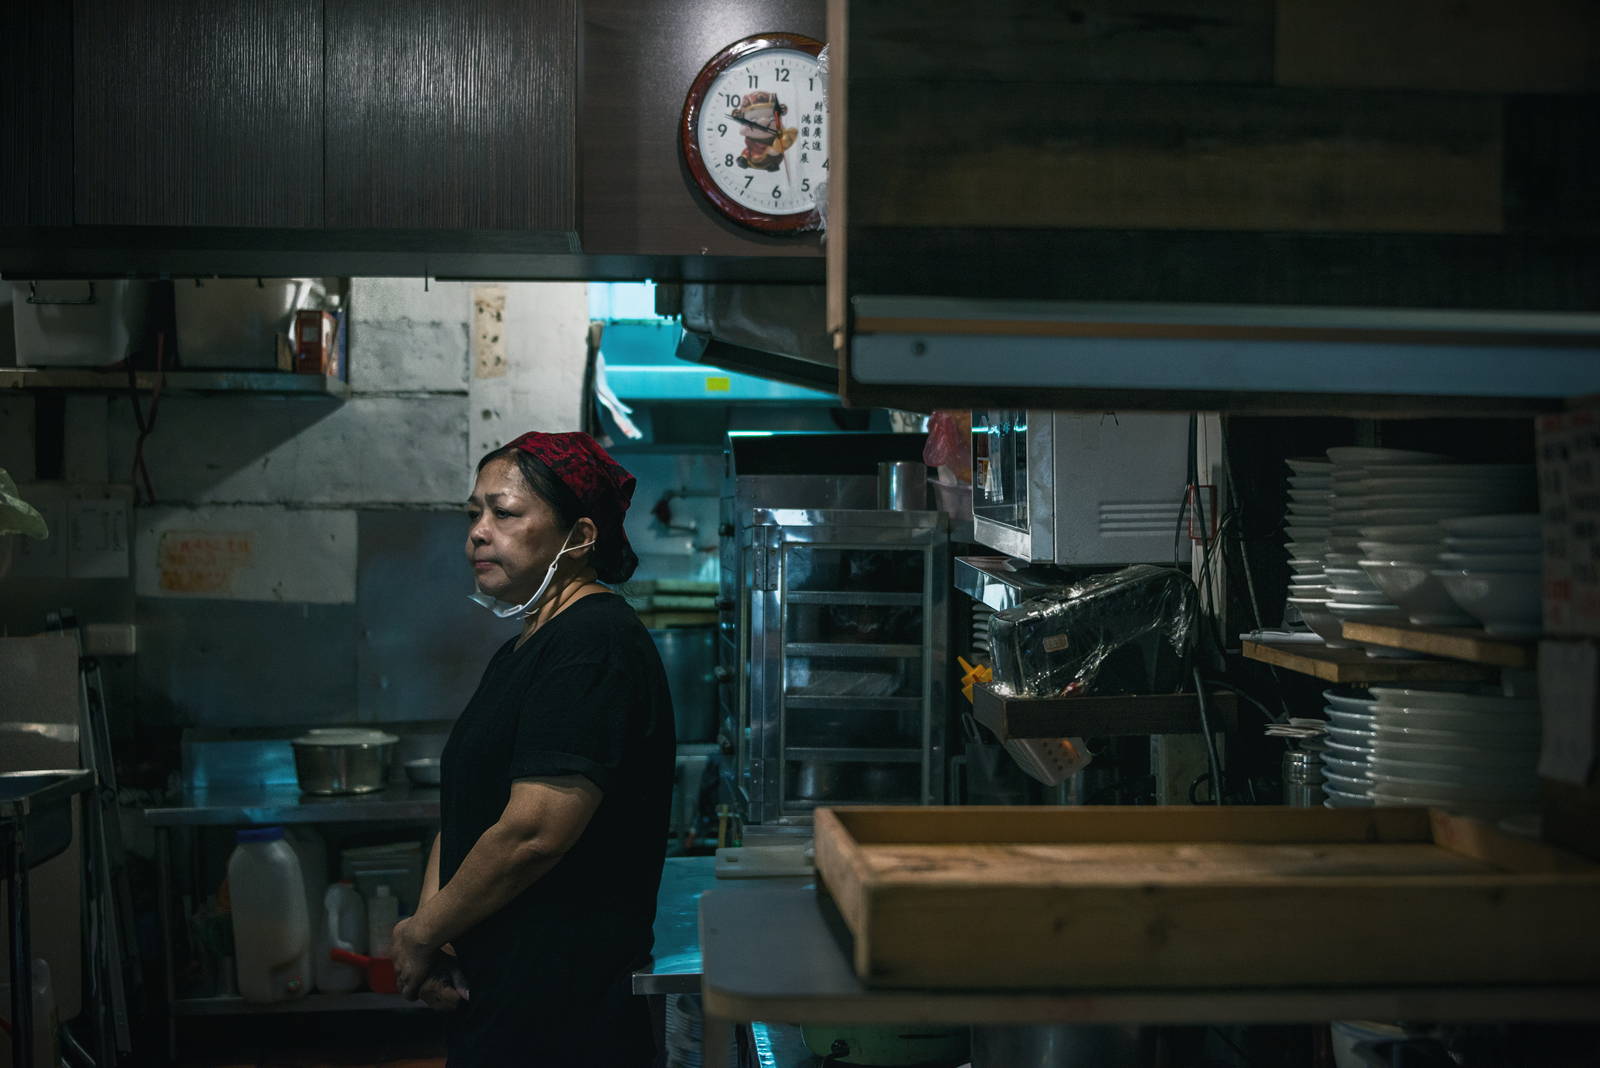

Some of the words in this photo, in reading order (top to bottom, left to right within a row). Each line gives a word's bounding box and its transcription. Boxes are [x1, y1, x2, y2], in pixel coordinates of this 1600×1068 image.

[775, 68, 790, 82] 12
[749, 75, 758, 89] 11
[725, 95, 740, 107] 10
[717, 124, 727, 137] 9
[726, 154, 734, 167] 8
[744, 176, 754, 189] 7
[801, 179, 810, 192] 5
[772, 186, 782, 199] 6
